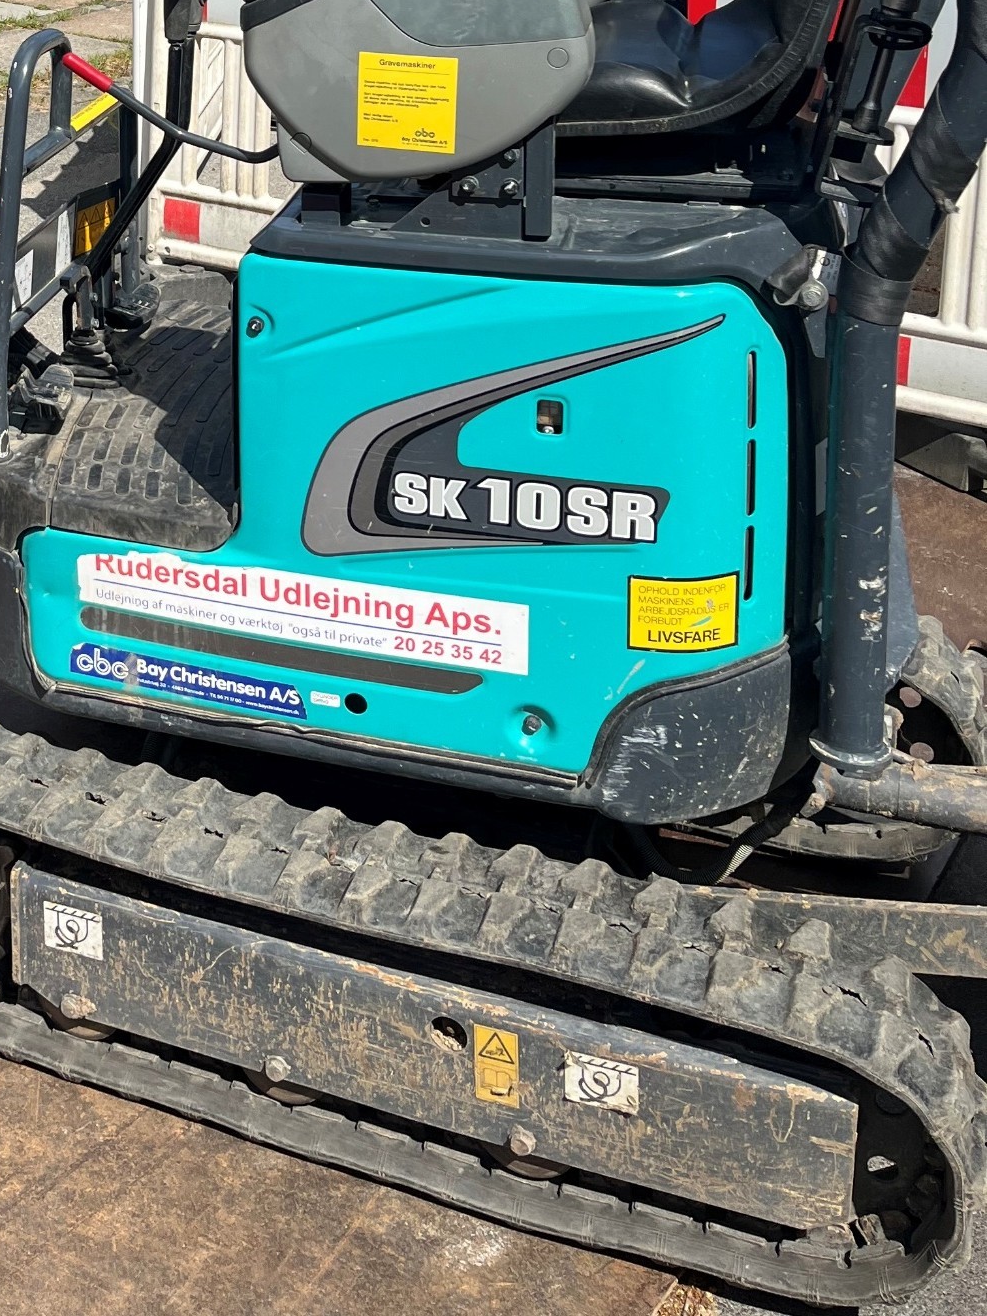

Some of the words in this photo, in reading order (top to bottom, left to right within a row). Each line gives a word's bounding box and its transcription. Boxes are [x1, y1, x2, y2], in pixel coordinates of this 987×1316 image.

[379, 59, 436, 70] Gravemaskiner
[95, 554, 247, 597] Rudersdal
[260, 576, 414, 629] Udlejning
[424, 601, 501, 635] Aps.
[638, 585, 680, 596] OPHOLD
[638, 595, 694, 606] MASKINENS
[639, 605, 716, 616] ARBEJDSRADIUS
[718, 603, 730, 612] ER
[96, 588, 149, 609] Udlejning
[152, 600, 163, 610] af
[165, 602, 217, 620] maskiner
[220, 612, 235, 626] og
[239, 616, 283, 634] værktøj
[324, 630, 336, 640] til
[394, 635, 416, 652] 20
[422, 640, 445, 656] 25
[450, 644, 474, 661] 35
[479, 648, 503, 665] 42
[637, 615, 683, 626] FORBUDT
[647, 627, 721, 644] LIVSFARE
[76, 647, 129, 679] cbc
[136, 658, 168, 682] Bay
[169, 666, 266, 700] Christensen
[269, 686, 301, 706] A/S
